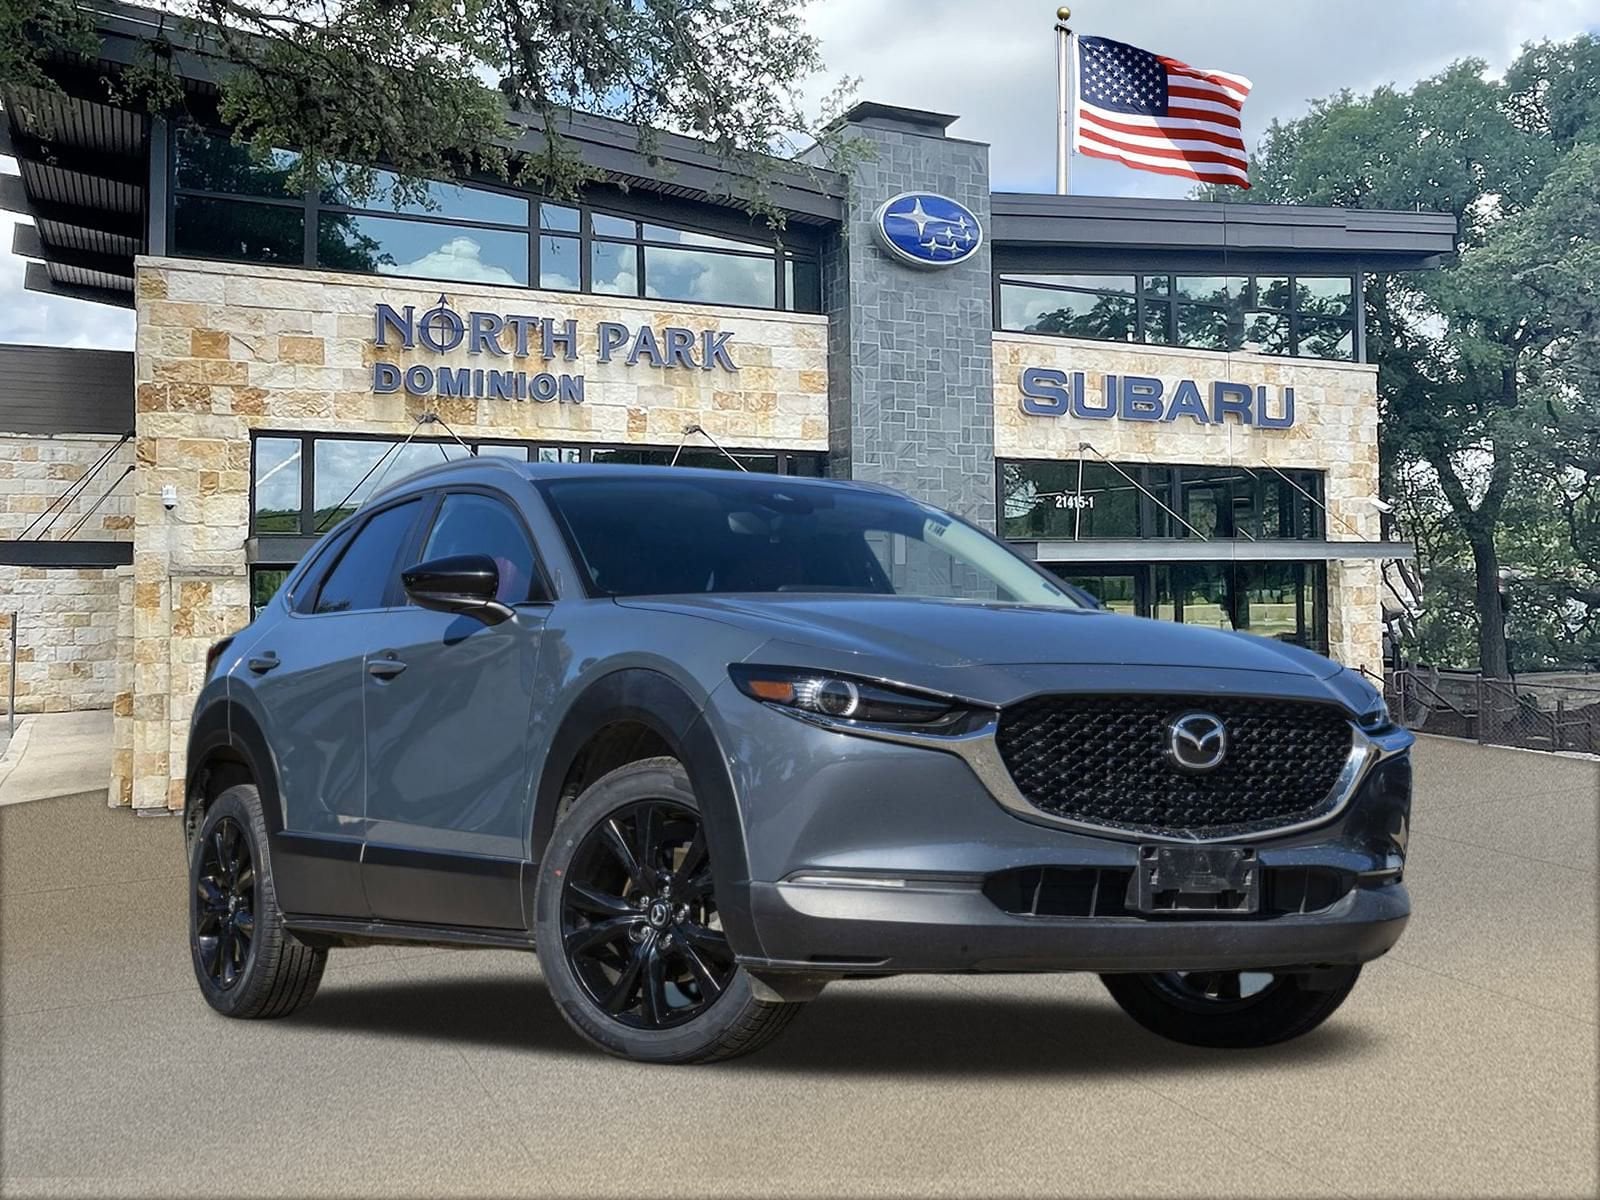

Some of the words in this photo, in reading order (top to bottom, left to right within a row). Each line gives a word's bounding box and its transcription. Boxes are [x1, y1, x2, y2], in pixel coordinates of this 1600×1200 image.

[375, 294, 579, 361] NORTH
[597, 322, 741, 372] PARK
[373, 362, 584, 404] DOMINION
[1018, 367, 1295, 429] SUBARU
